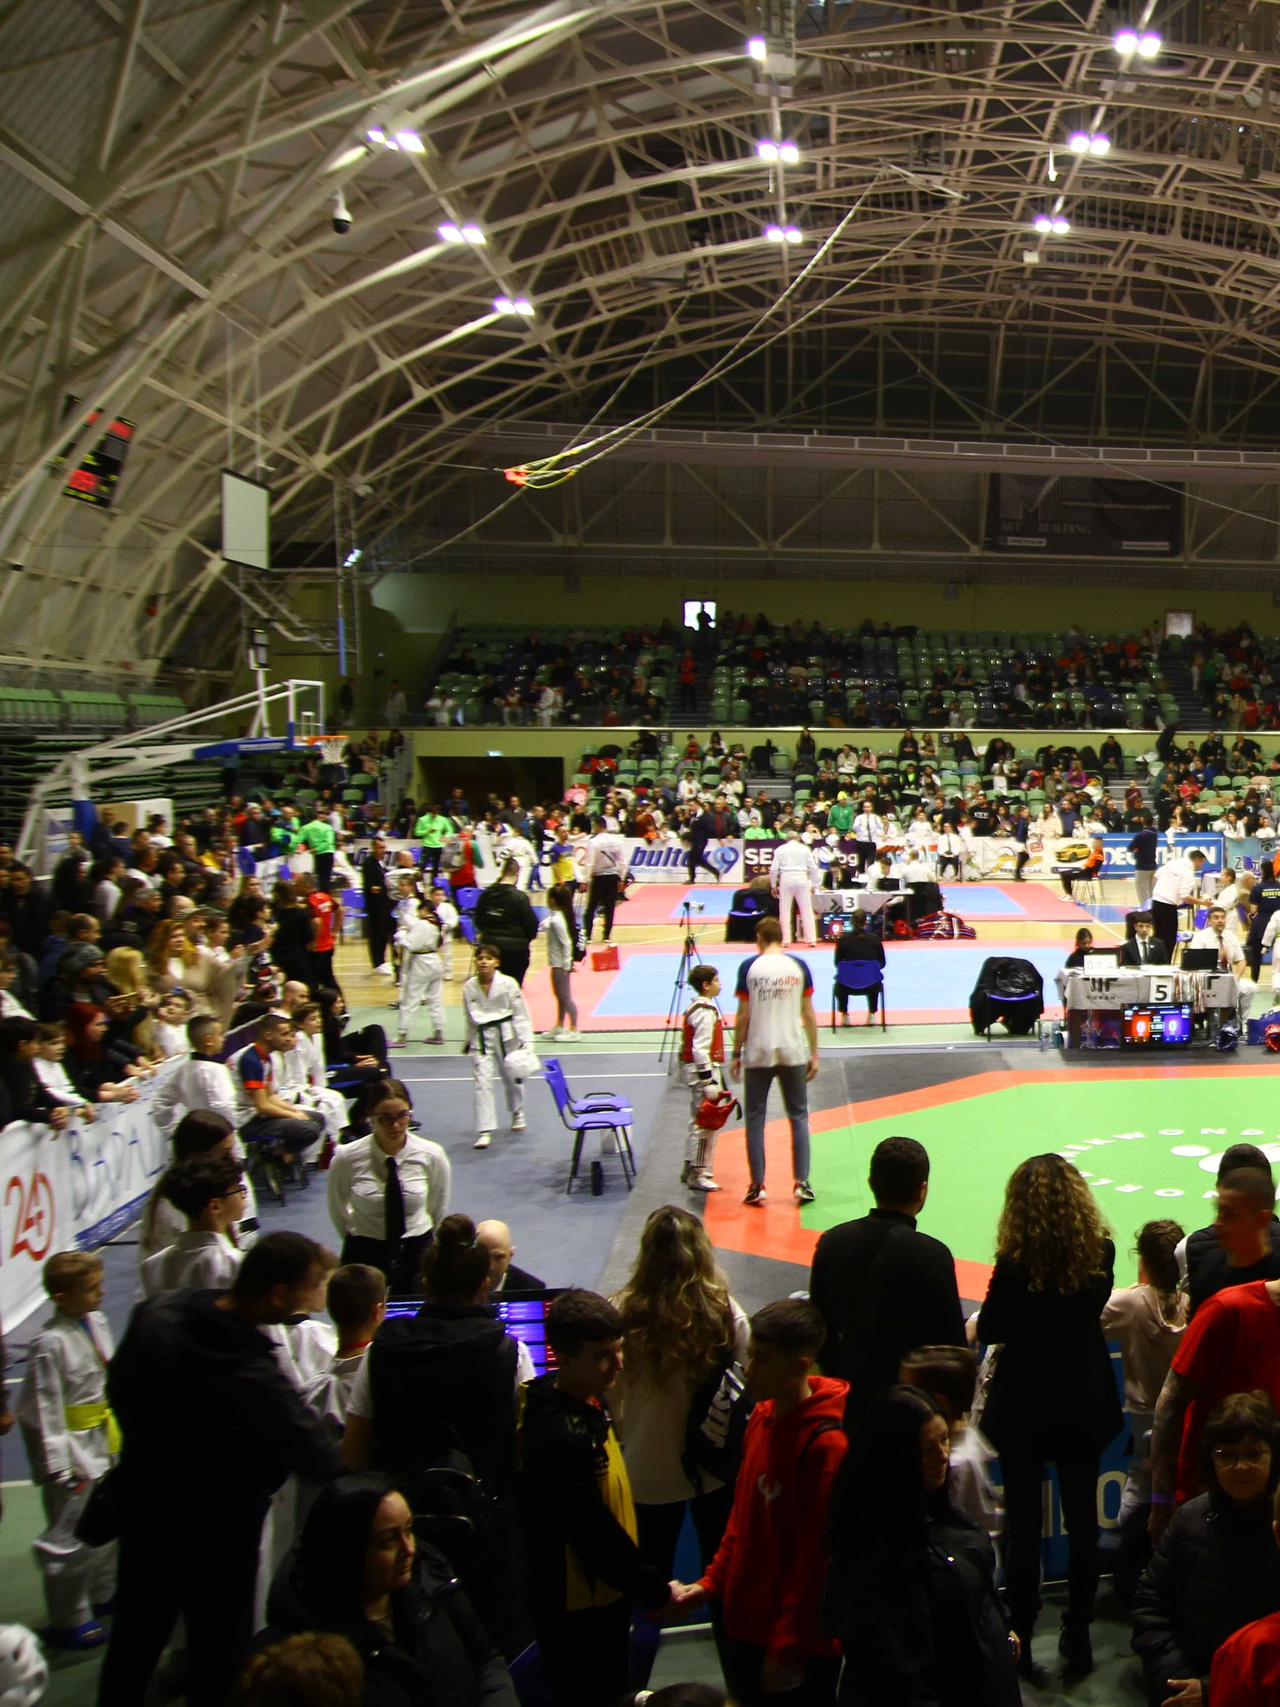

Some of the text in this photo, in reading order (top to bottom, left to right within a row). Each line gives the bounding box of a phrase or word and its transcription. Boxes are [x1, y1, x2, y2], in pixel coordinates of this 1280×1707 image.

[845, 897, 855, 909] 3
[1155, 985, 1168, 1001] 5
[1136, 1021, 1146, 1033] 0
[1168, 1020, 1177, 1031] 0
